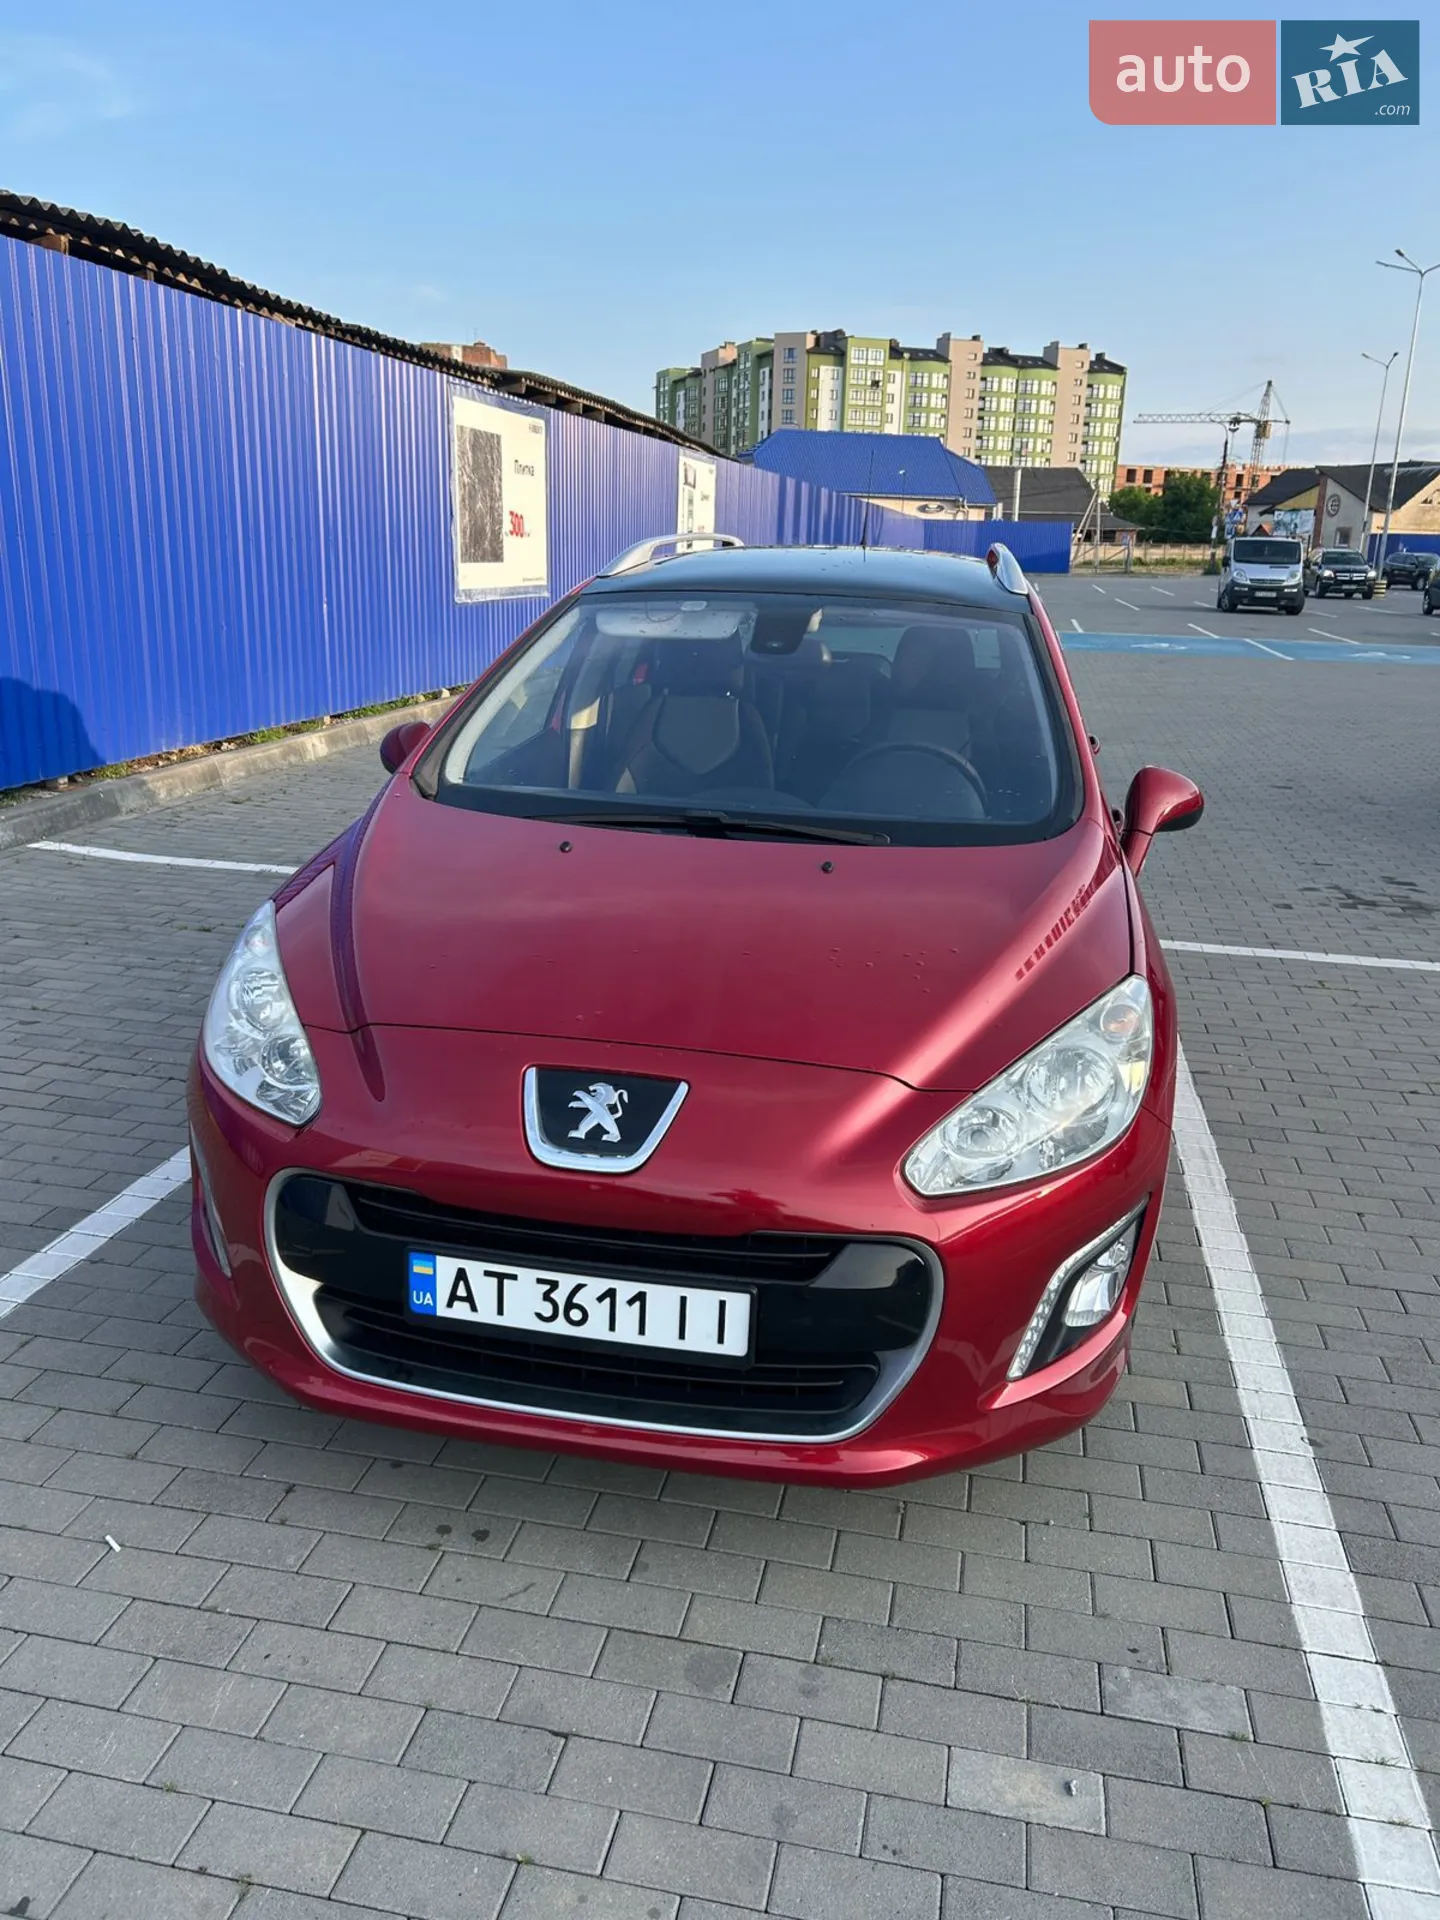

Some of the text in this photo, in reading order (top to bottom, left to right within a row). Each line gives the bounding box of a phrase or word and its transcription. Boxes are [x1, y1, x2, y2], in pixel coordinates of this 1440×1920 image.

[413, 1290, 434, 1307] UA
[446, 1267, 518, 1316] AT
[534, 1277, 648, 1336] 3611
